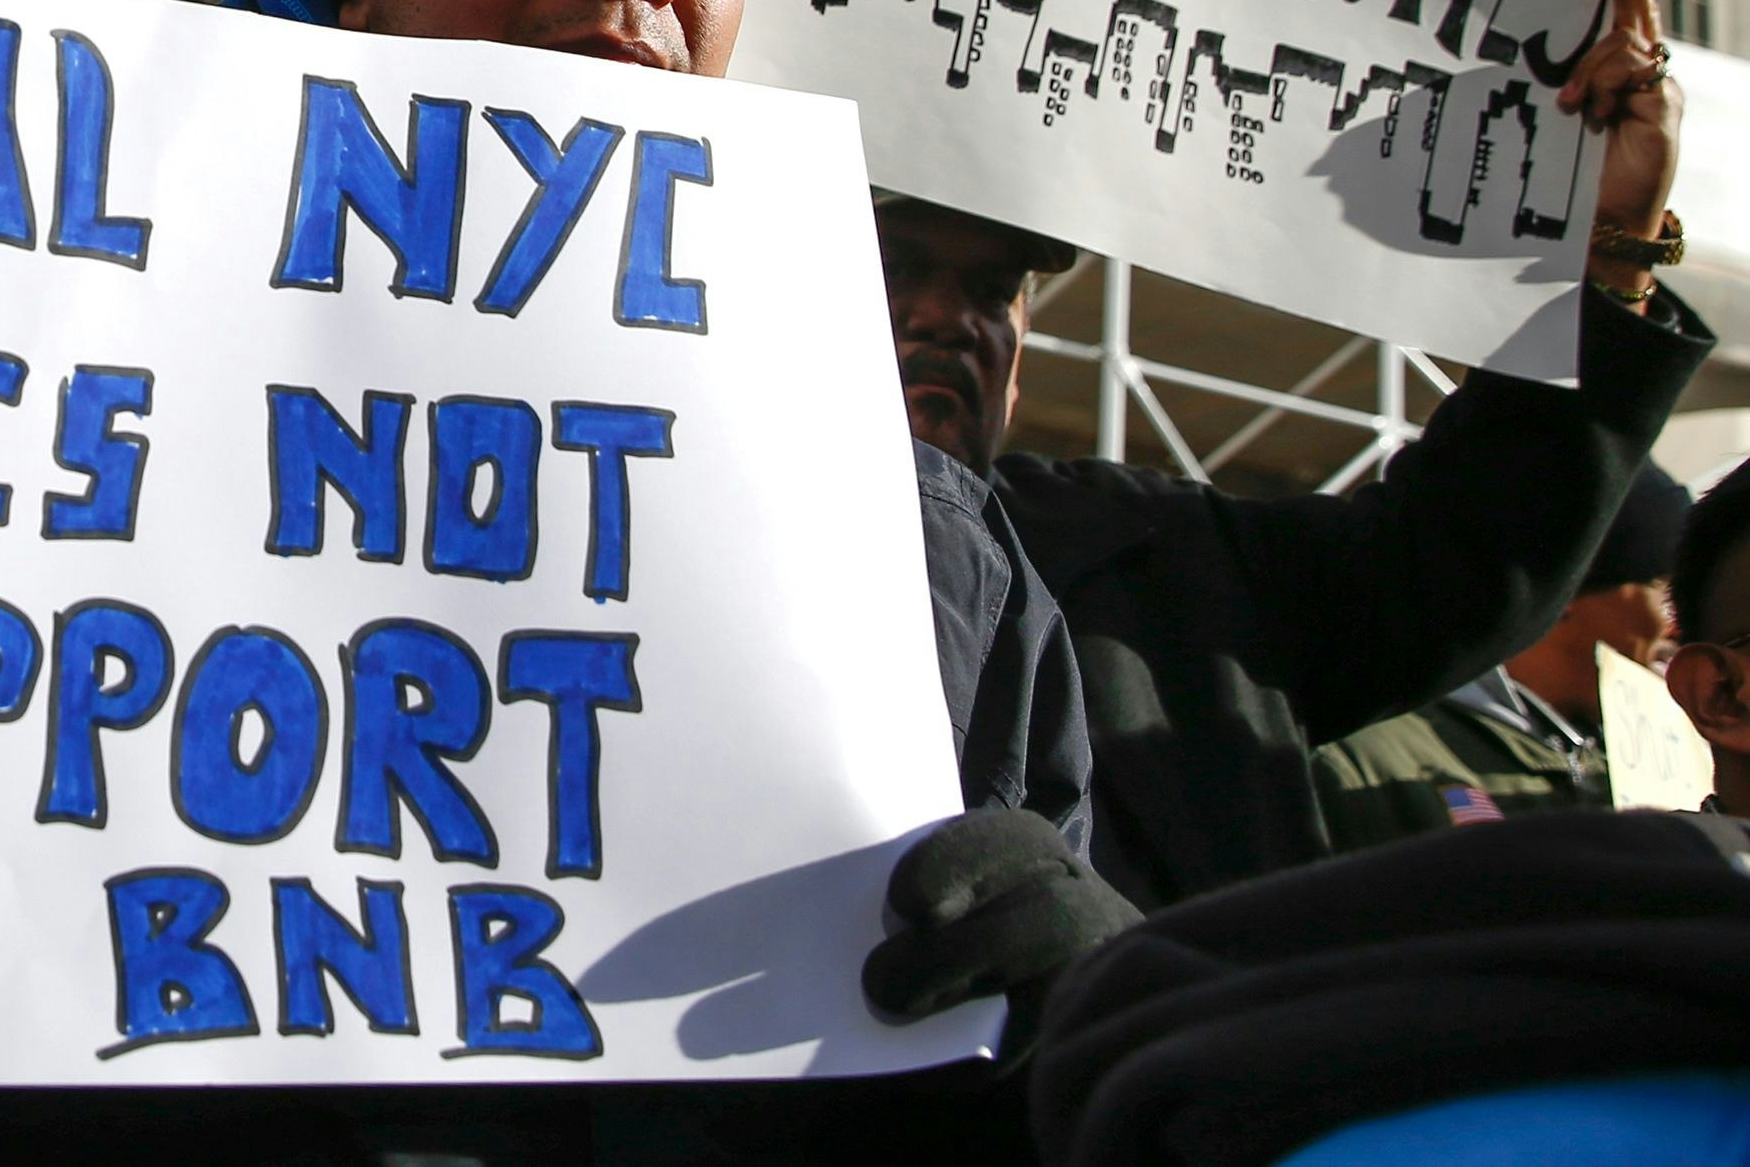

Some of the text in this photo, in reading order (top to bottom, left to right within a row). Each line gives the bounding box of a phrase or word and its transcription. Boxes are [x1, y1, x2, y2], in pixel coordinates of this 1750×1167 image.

[270, 75, 711, 334] NYC
[265, 383, 674, 603] NOT
[94, 866, 604, 1062] BNB
